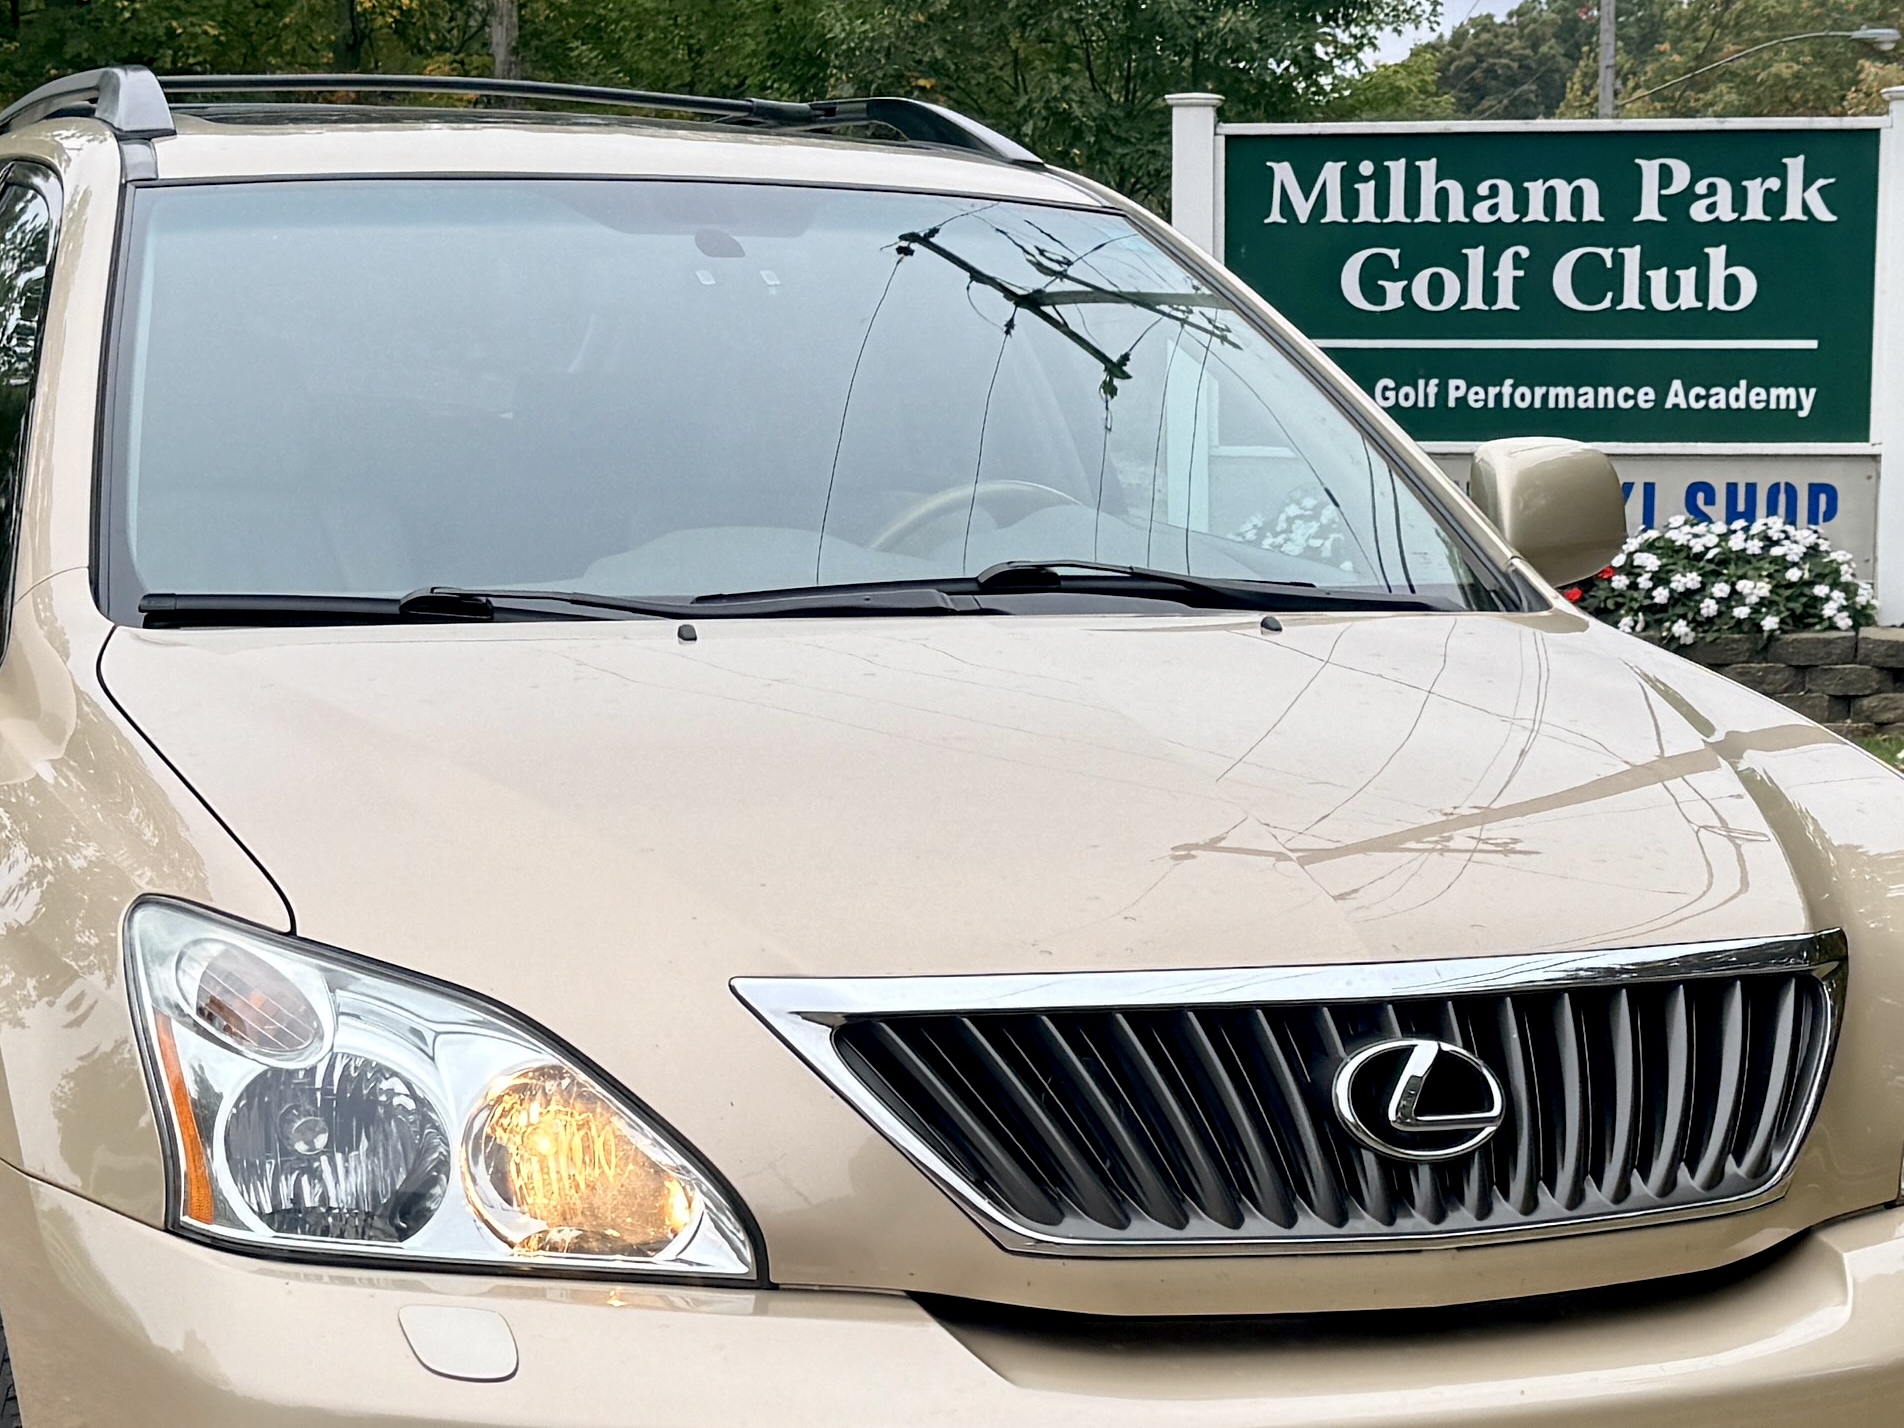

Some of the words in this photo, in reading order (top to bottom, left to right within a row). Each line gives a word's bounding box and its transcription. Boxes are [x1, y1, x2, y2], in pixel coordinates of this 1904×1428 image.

[1264, 158, 1604, 224] Milham
[1633, 154, 1838, 223] Park
[1341, 246, 1530, 312] Golf
[1553, 245, 1758, 312] Club
[1374, 377, 1439, 408] Golf
[1448, 378, 1656, 409] Performance
[1665, 379, 1817, 418] Academy
[1684, 481, 1839, 528] SHOP
